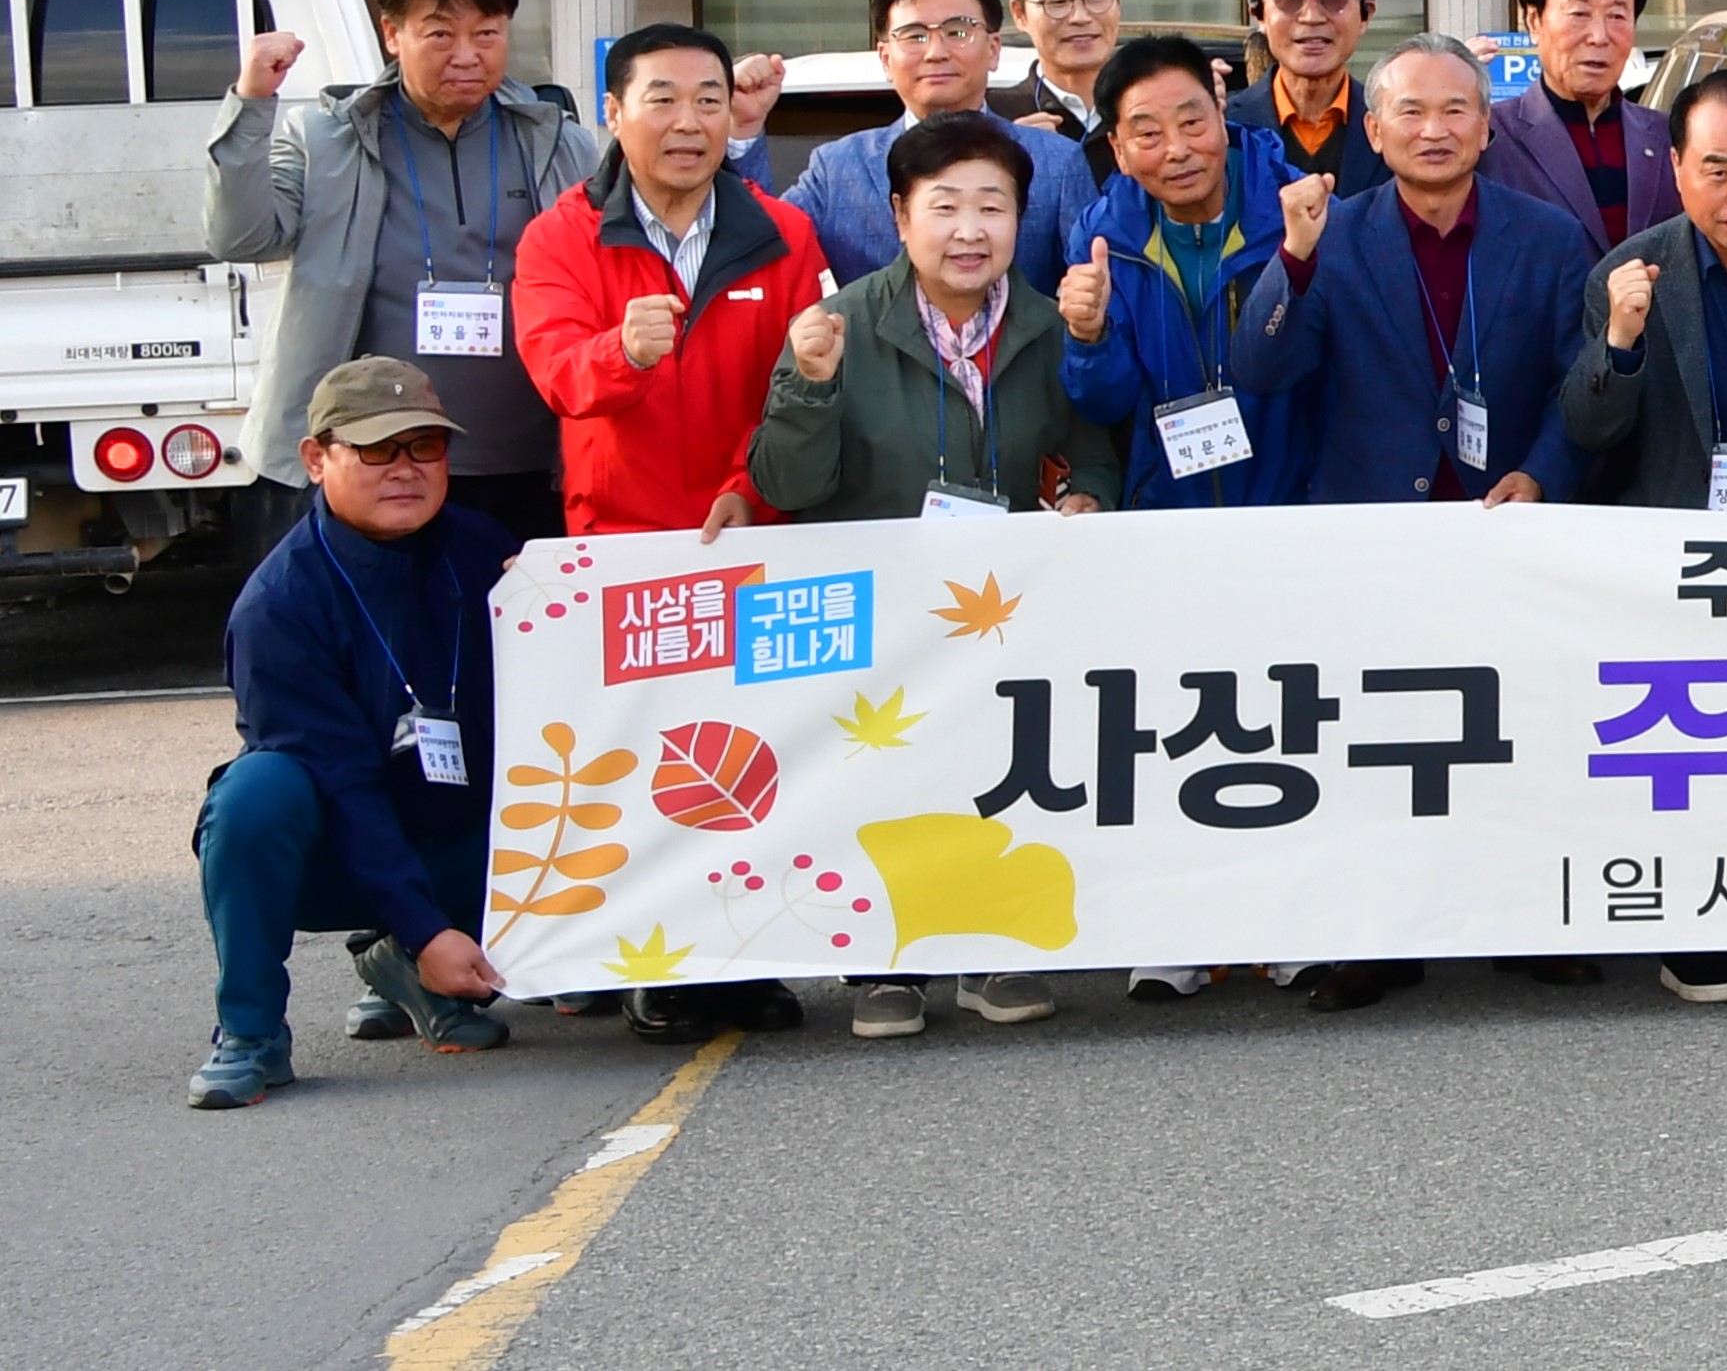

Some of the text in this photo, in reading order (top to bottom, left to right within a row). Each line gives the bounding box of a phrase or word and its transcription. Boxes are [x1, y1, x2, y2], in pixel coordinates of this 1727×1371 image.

[1504, 56, 1526, 82] P
[64, 342, 193, 360] 최대적재량 800kg
[619, 579, 726, 630] 사상을
[751, 581, 857, 630] 구민을
[619, 619, 726, 671] 새롭게
[751, 624, 856, 674] 힘나게
[973, 662, 1514, 829] 사상구
